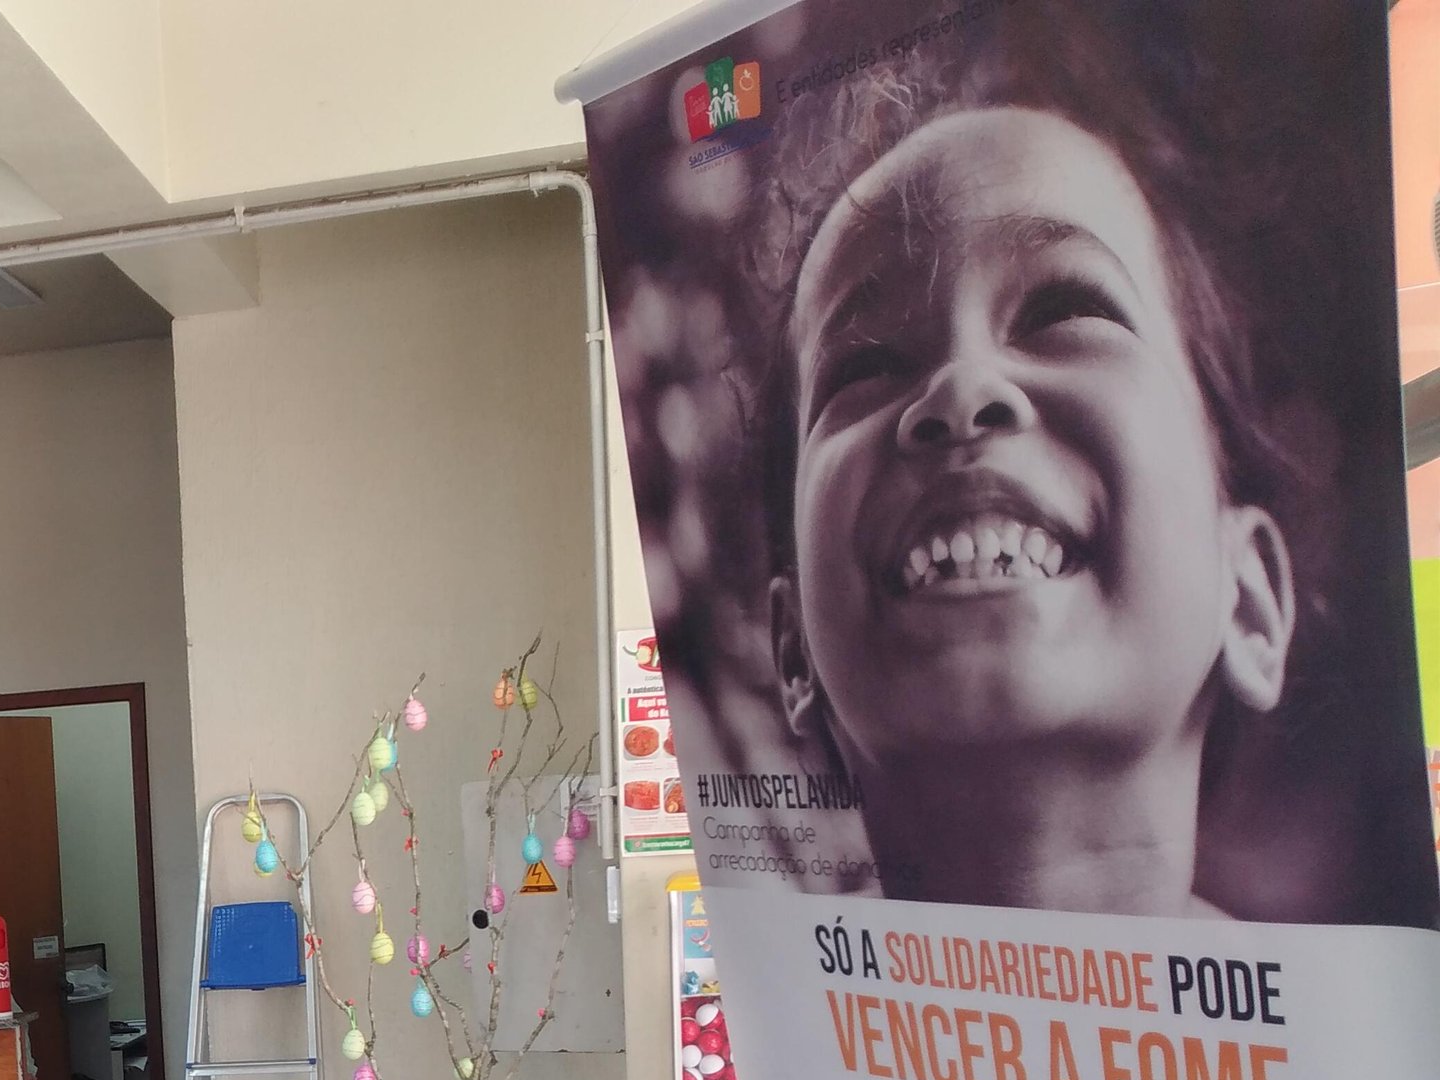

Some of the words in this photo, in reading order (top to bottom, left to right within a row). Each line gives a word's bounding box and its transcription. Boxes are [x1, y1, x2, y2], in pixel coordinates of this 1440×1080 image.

[703, 816, 790, 848] Campanha
[794, 821, 816, 844] de
[709, 851, 807, 881] arrecadação
[811, 852, 833, 876] de
[814, 916, 852, 976] SÓ
[862, 929, 881, 980] A
[884, 931, 1159, 1012] SOLIDARIEDADE
[1168, 955, 1287, 1026] PODE
